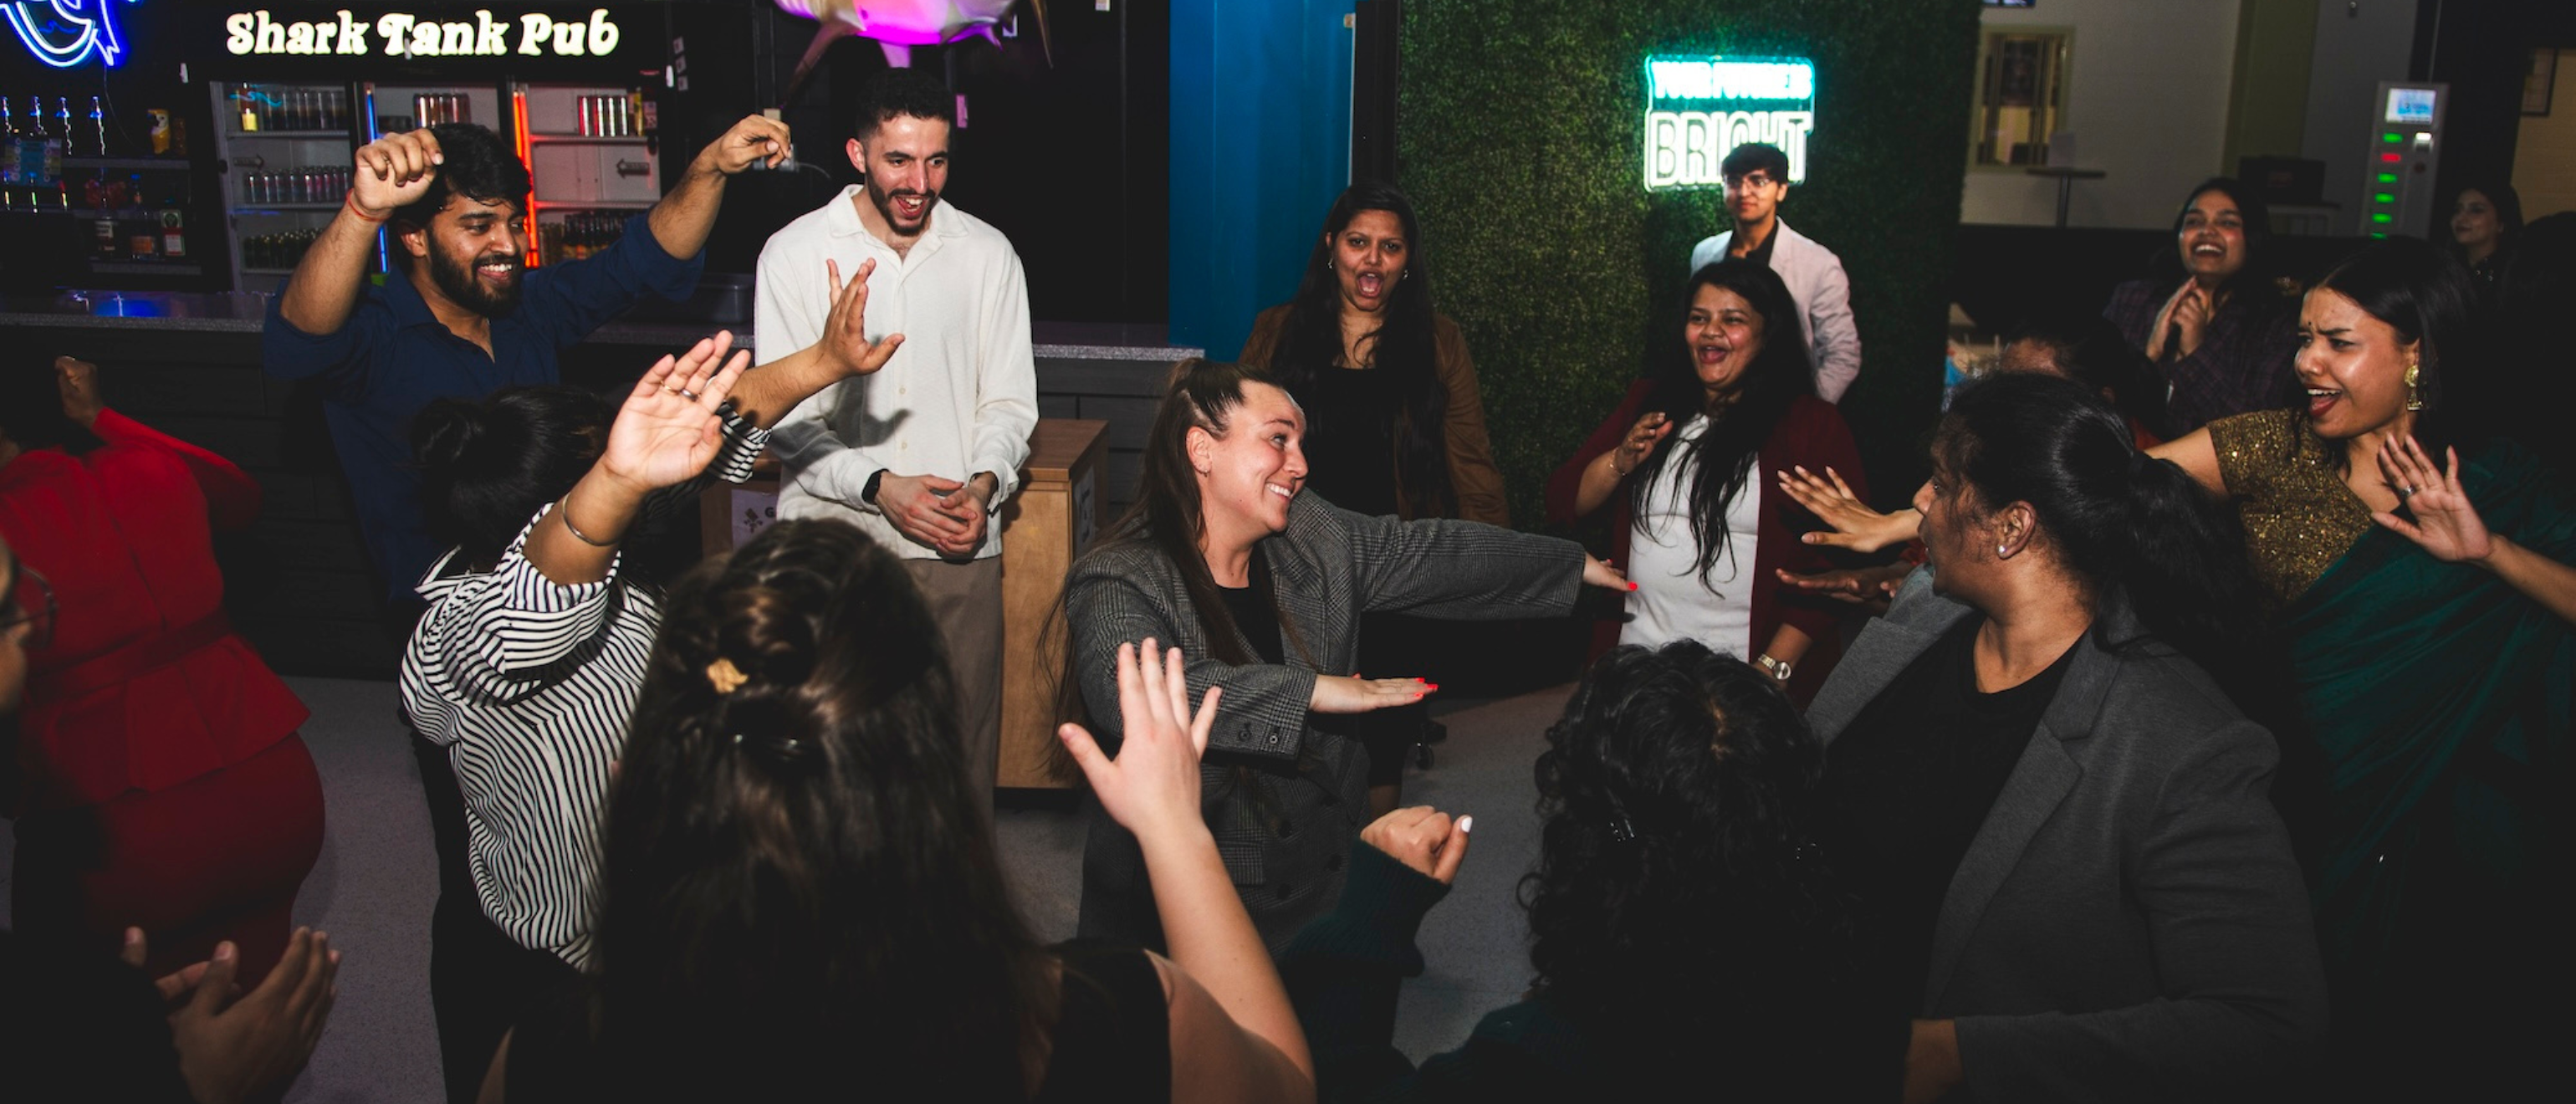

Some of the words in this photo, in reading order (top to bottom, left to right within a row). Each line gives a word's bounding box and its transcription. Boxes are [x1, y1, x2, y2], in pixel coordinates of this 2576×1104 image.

[227, 10, 370, 55] Shark
[376, 10, 510, 57] Tank
[518, 9, 620, 56] Pub
[1651, 61, 1712, 99] YOUR
